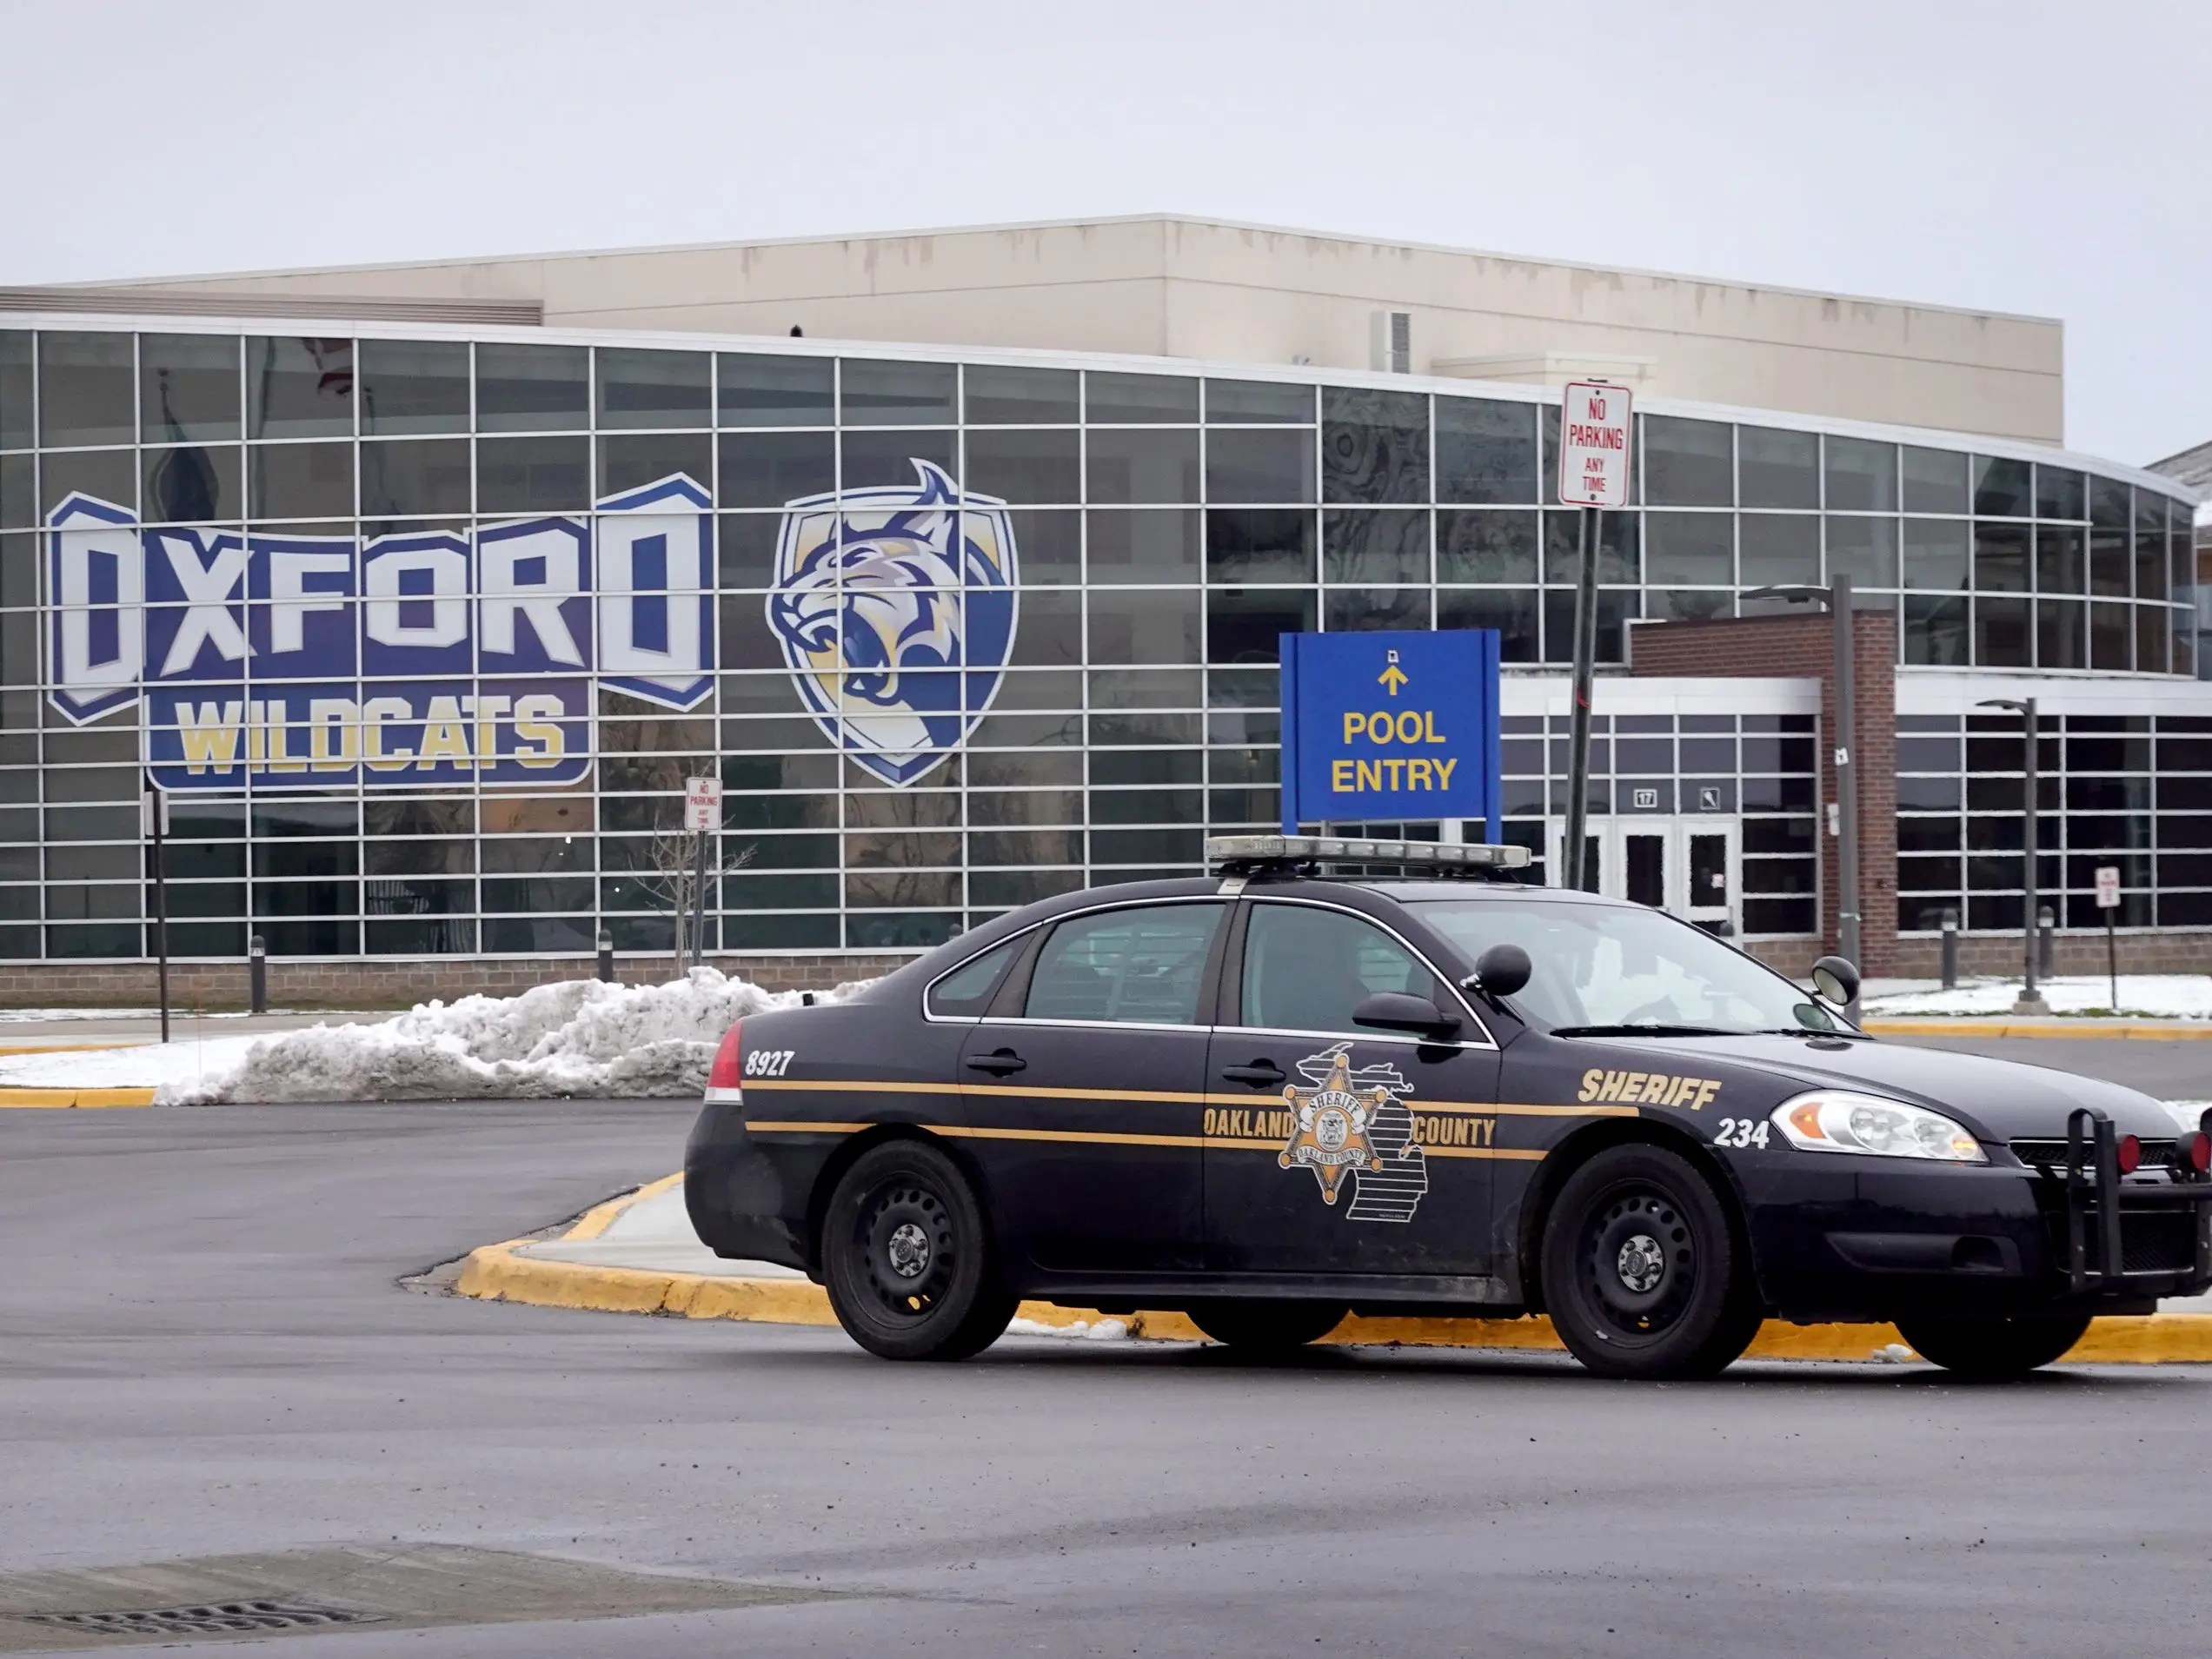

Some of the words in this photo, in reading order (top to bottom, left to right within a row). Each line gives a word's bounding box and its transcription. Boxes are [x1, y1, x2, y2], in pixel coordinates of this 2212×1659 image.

[1589, 398, 1606, 421] NO
[1570, 424, 1624, 450] PARKING
[1584, 457, 1604, 473] ANY
[1583, 475, 1606, 493] TIME
[58, 491, 705, 708] OXFORD
[175, 693, 565, 776] WILDCATS
[1344, 711, 1446, 745] POOL
[1332, 758, 1458, 793] ENTRY
[745, 1050, 795, 1076] 8927
[1309, 1092, 1362, 1113] SHERIFF
[1578, 1068, 1723, 1111] SHERIFF
[1203, 1108, 1296, 1138] OAKLAND
[1412, 1116, 1496, 1146] COUNTY
[1714, 1118, 1770, 1149] 234
[1299, 1147, 1336, 1164] OAKLAND
